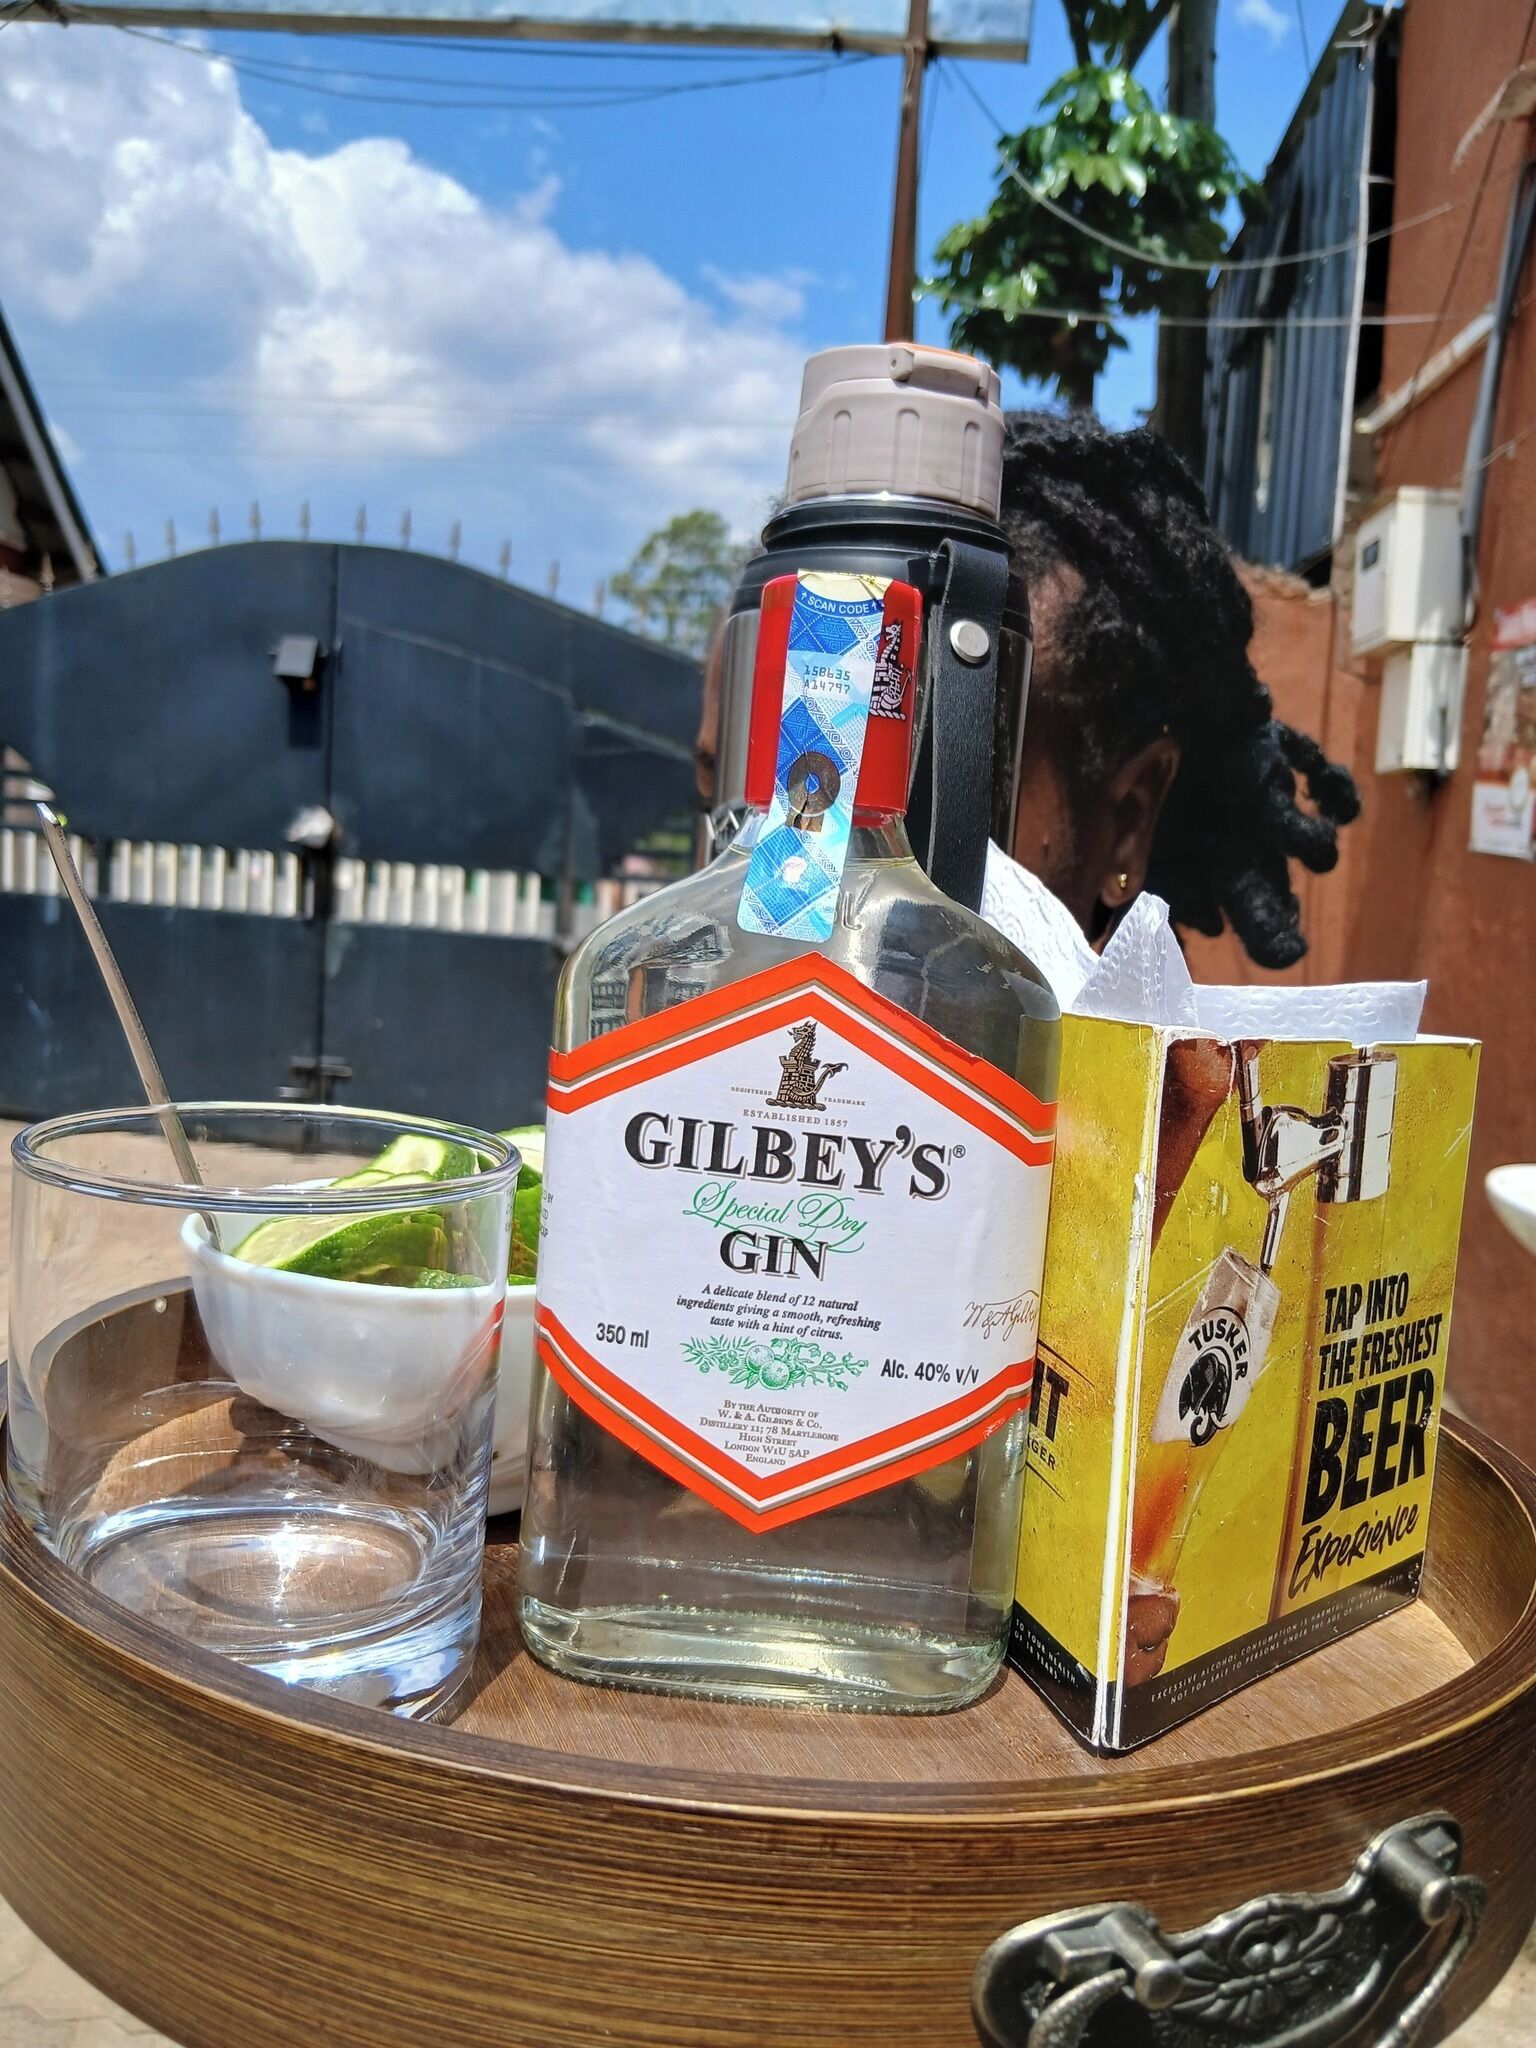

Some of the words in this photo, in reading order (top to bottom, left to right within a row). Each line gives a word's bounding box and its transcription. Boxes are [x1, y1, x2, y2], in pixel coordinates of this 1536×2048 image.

[808, 596, 836, 613] SCAN
[839, 604, 870, 614] CODE
[731, 1086, 773, 1096] REGISTERED
[824, 1097, 866, 1106] TRADEMARK
[743, 1109, 821, 1124] ESTABLISHED
[825, 1118, 848, 1128] 1857
[682, 1181, 794, 1228] Special
[797, 1193, 869, 1240] Dry
[720, 1230, 831, 1281] GIN
[676, 1295, 735, 1312] ingredients
[736, 1303, 770, 1318] giving
[772, 1309, 779, 1317] a
[781, 1309, 824, 1324] smooth,
[825, 1314, 882, 1332] refreshing
[702, 1284, 711, 1295] A
[713, 1285, 754, 1300] delicate
[756, 1289, 786, 1304] blend
[788, 1294, 802, 1307] of
[802, 1295, 816, 1307] 12
[818, 1299, 859, 1312] natural
[1323, 1283, 1362, 1336] TAP
[1365, 1272, 1410, 1325] INTO
[596, 1322, 626, 1344] 350
[630, 1330, 649, 1348] ml
[710, 1315, 735, 1328] taste
[737, 1318, 760, 1331] with
[762, 1323, 770, 1332] a
[772, 1322, 794, 1334] hint
[796, 1324, 809, 1337] of
[810, 1328, 843, 1340] citrus.
[1188, 1318, 1248, 1380] TUSKER
[1319, 1337, 1358, 1392] THE
[1359, 1312, 1443, 1380] FRESHEST
[880, 1358, 909, 1379] Alc.
[914, 1361, 951, 1383] 40%
[956, 1365, 980, 1386] v/v
[717, 1409, 732, 1419] W.
[796, 1419, 806, 1428] &
[766, 1426, 779, 1436] 78
[1028, 1434, 1056, 1471] GER
[1301, 1367, 1435, 1526] BEER
[1016, 1618, 1024, 1631] TO
[1028, 1630, 1046, 1654] YOUR
[1151, 1674, 1197, 1702] EXCESSIVE
[1201, 1654, 1237, 1676] ALCOHOL
[1241, 1623, 1298, 1656] CONSUMPTION
[1170, 1690, 1188, 1705] NOT
[1191, 1681, 1206, 1694] FOR
[1210, 1669, 1229, 1683] SALE
[1232, 1662, 1242, 1671] TO
[1245, 1643, 1280, 1665] PERSONS
[1283, 1628, 1308, 1644] UNDER
[1311, 1622, 1325, 1631] THE
[1327, 1614, 1340, 1625] AGE
